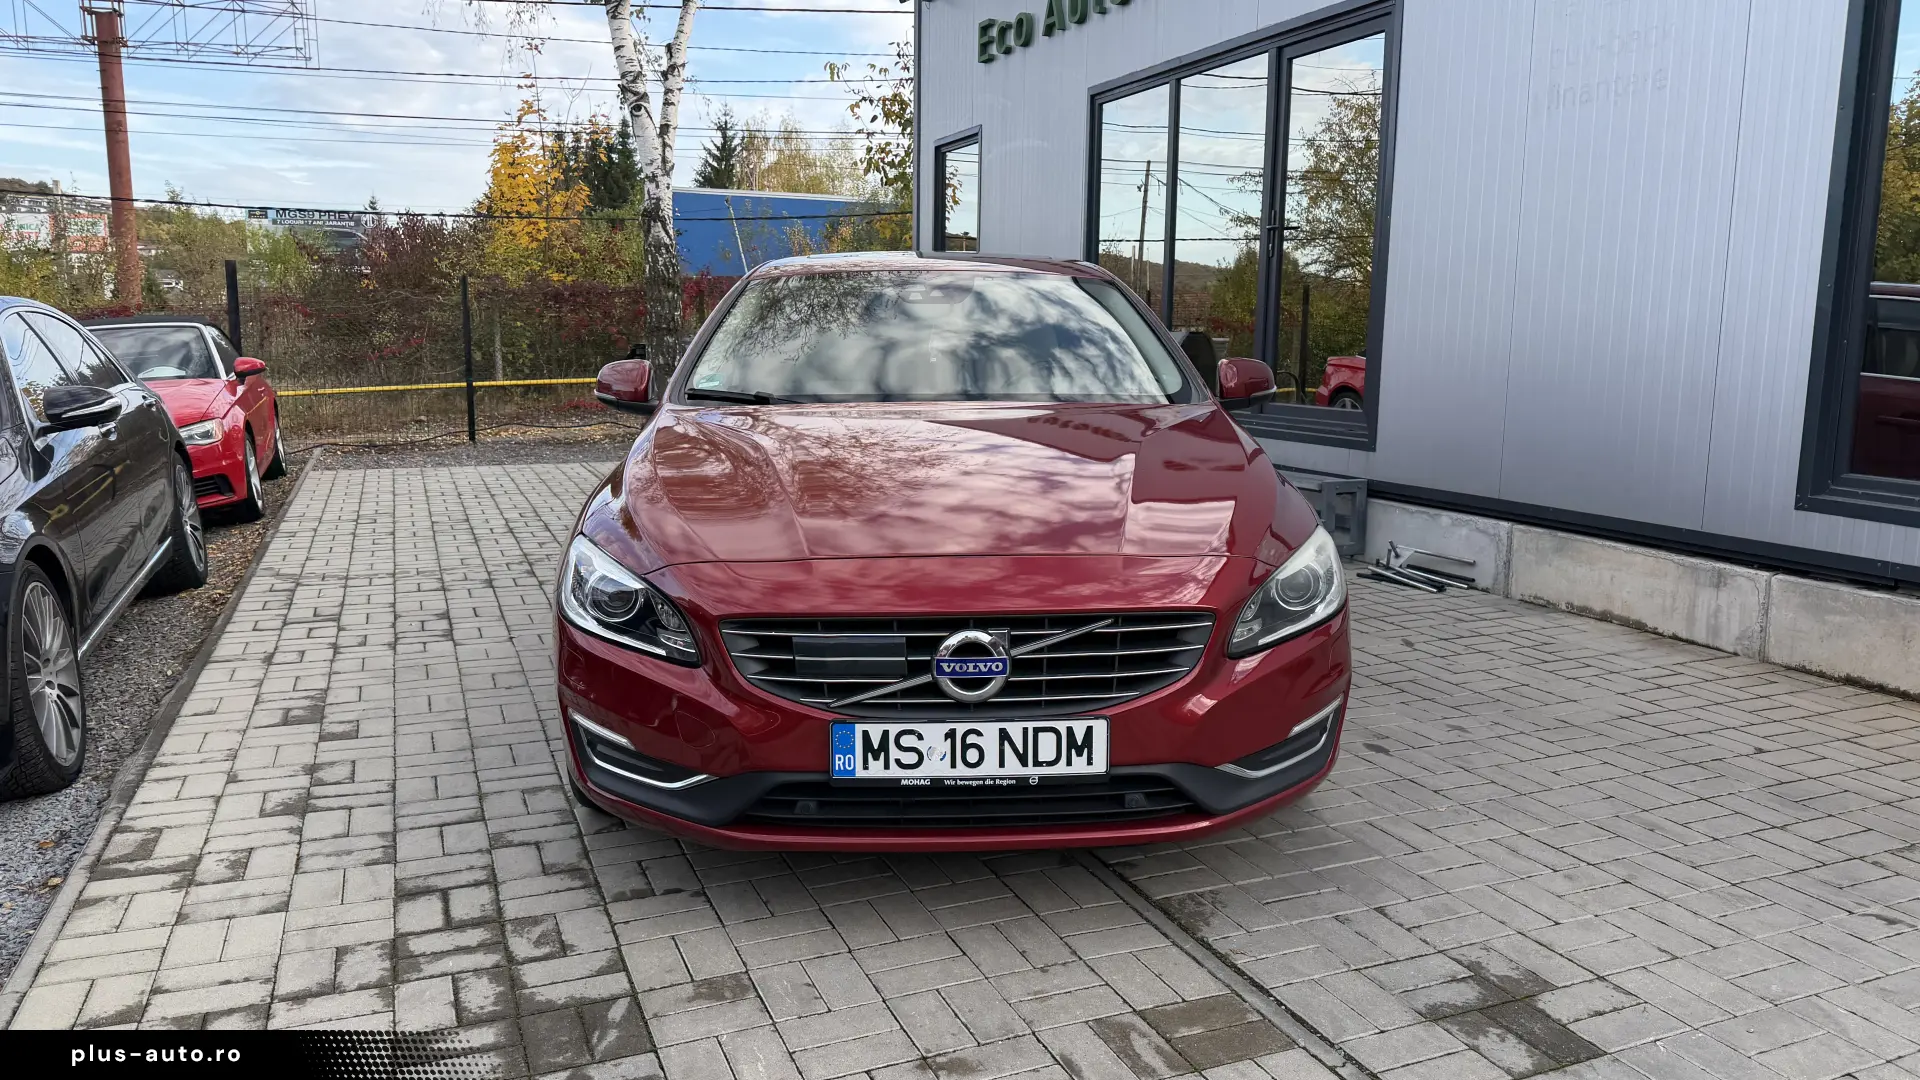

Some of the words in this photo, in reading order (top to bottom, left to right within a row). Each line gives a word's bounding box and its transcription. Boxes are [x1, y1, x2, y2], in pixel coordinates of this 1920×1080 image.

[1042, 0, 1132, 37] Au
[275, 209, 315, 219] MGS9
[319, 211, 355, 221] PHEV
[940, 662, 1003, 673] VOLVO
[862, 729, 925, 771] MS
[944, 728, 985, 769] 16
[998, 725, 1094, 768] NDM
[835, 754, 855, 771] RO
[956, 779, 984, 787] bewegen
[995, 778, 1016, 787] Region
